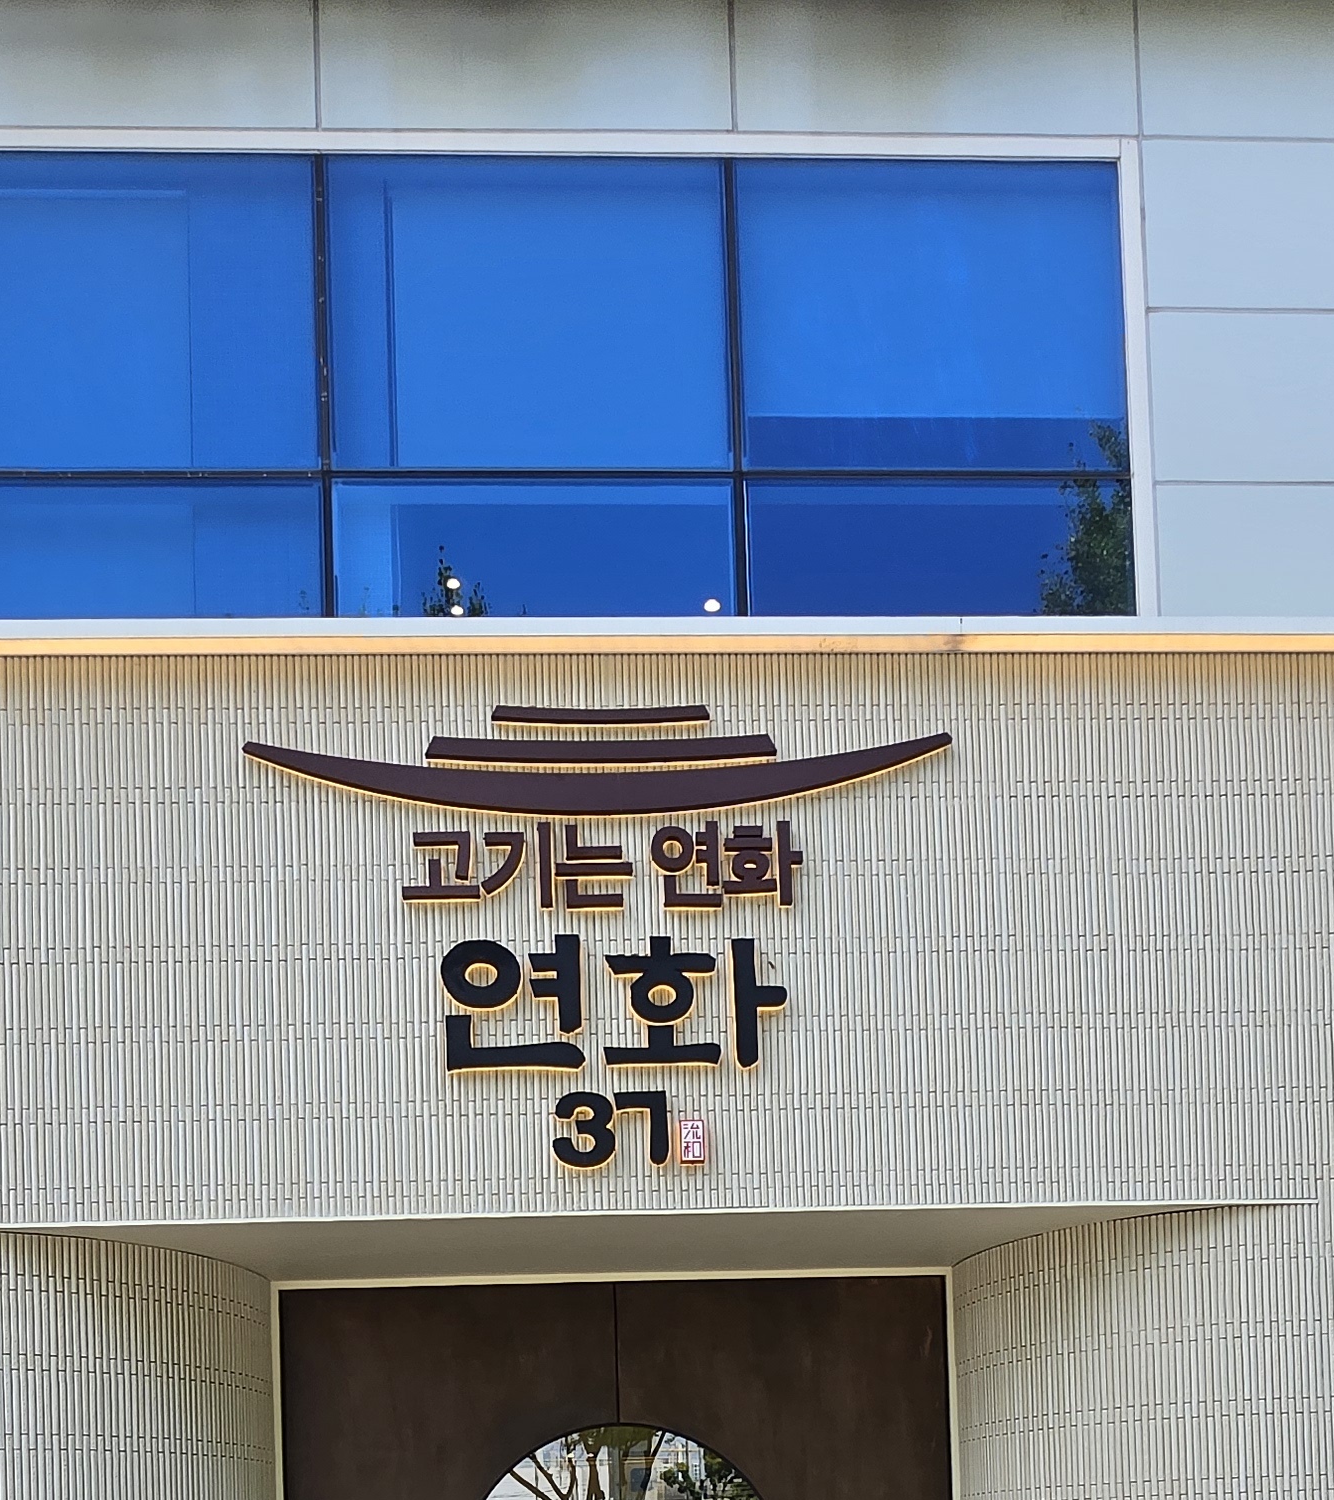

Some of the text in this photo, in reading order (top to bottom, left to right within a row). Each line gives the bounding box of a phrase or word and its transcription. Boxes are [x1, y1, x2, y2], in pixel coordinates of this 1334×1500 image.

[402, 820, 805, 912] 고기는 연화
[440, 934, 788, 1073] 연화
[552, 1089, 668, 1169] 37
